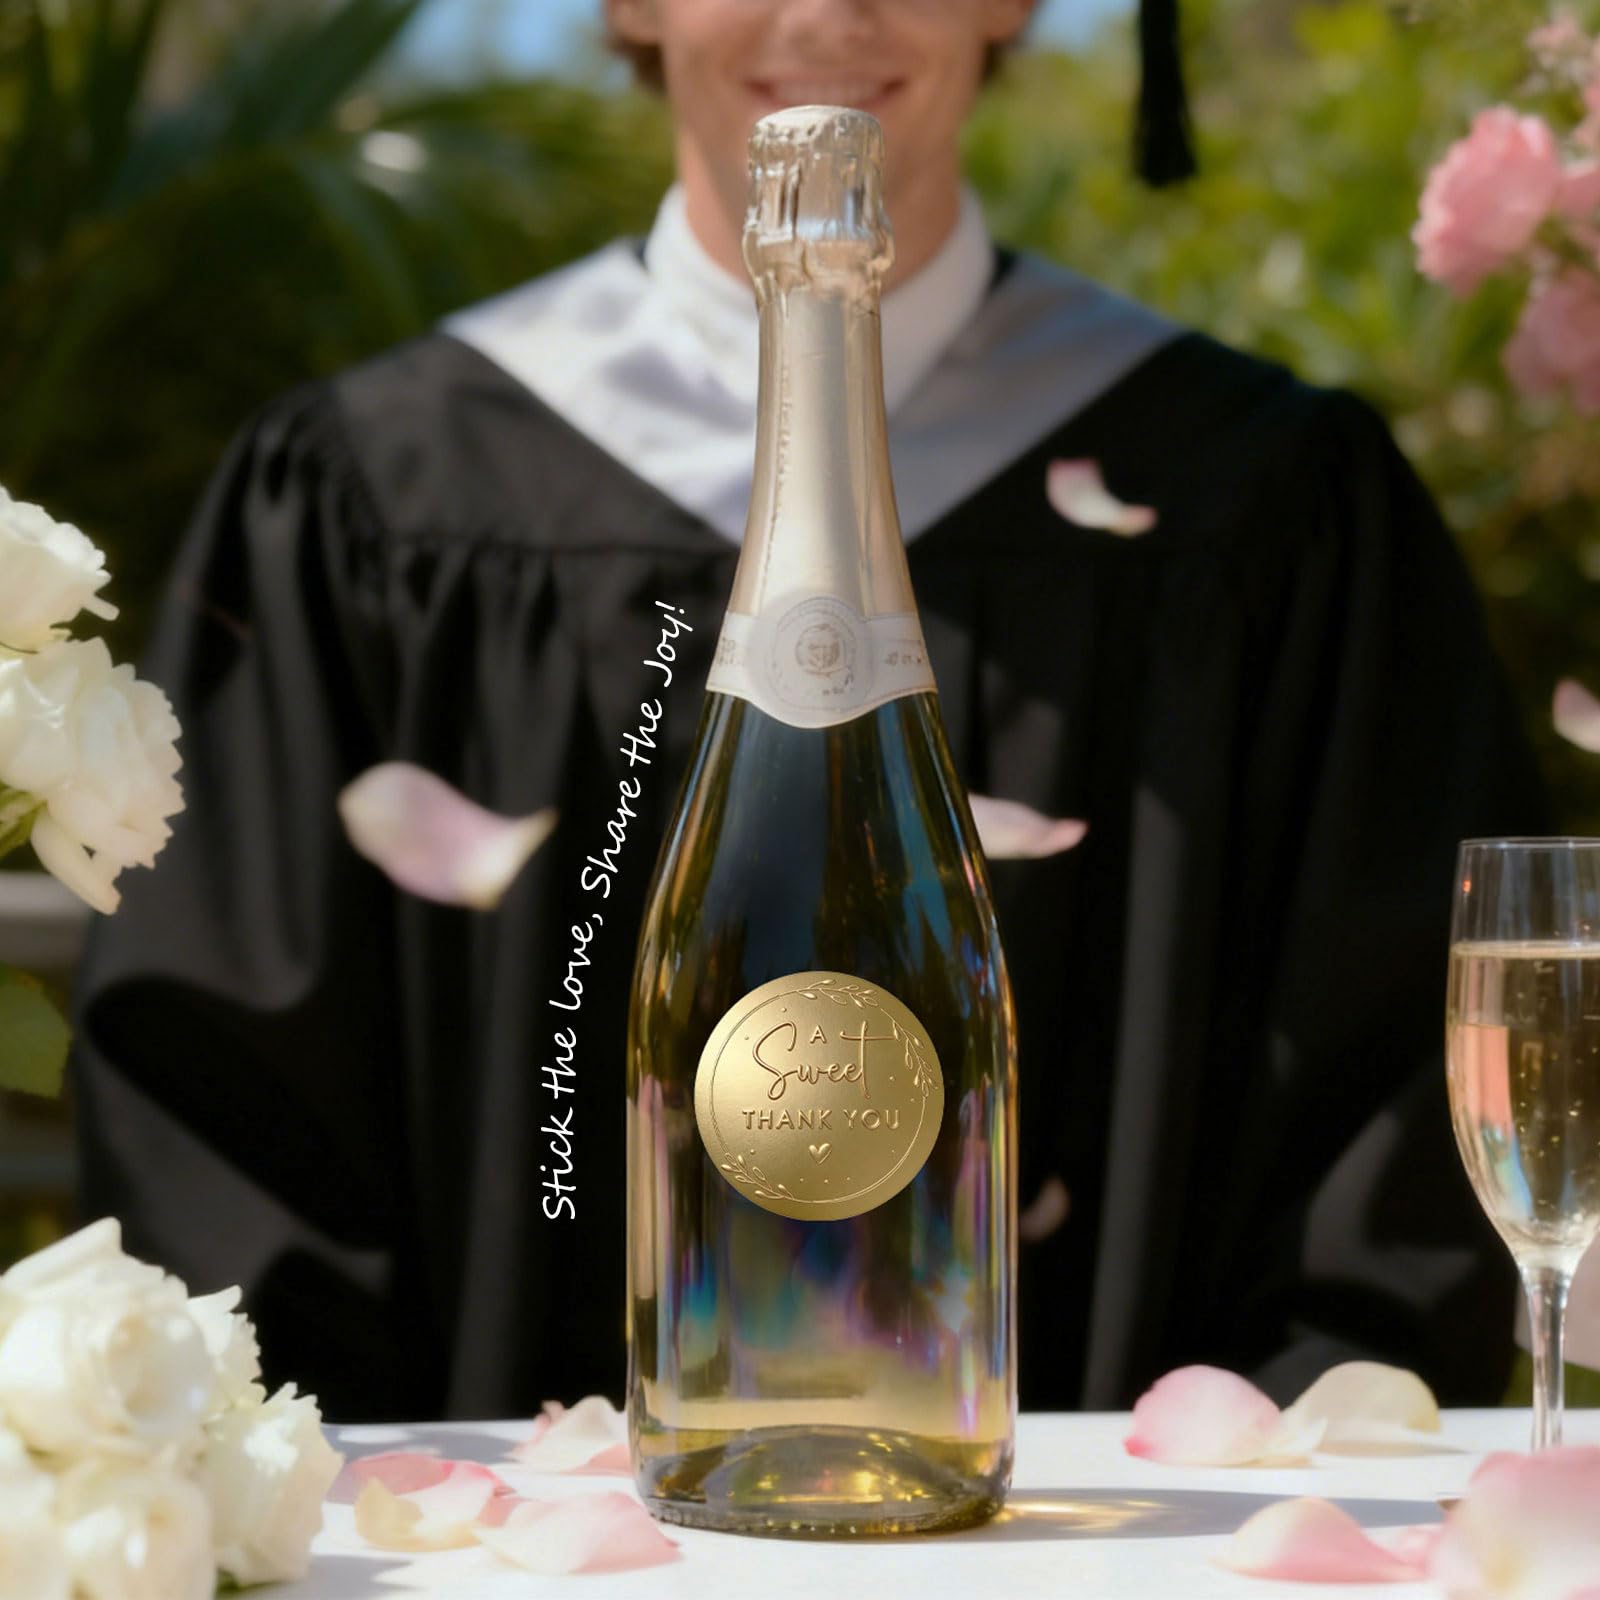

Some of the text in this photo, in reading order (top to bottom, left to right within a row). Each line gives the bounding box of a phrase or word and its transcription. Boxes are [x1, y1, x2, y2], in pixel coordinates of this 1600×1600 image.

[809, 1025, 827, 1044] A
[752, 1020, 897, 1100] Sweet
[742, 1109, 901, 1131] THANK YOU
